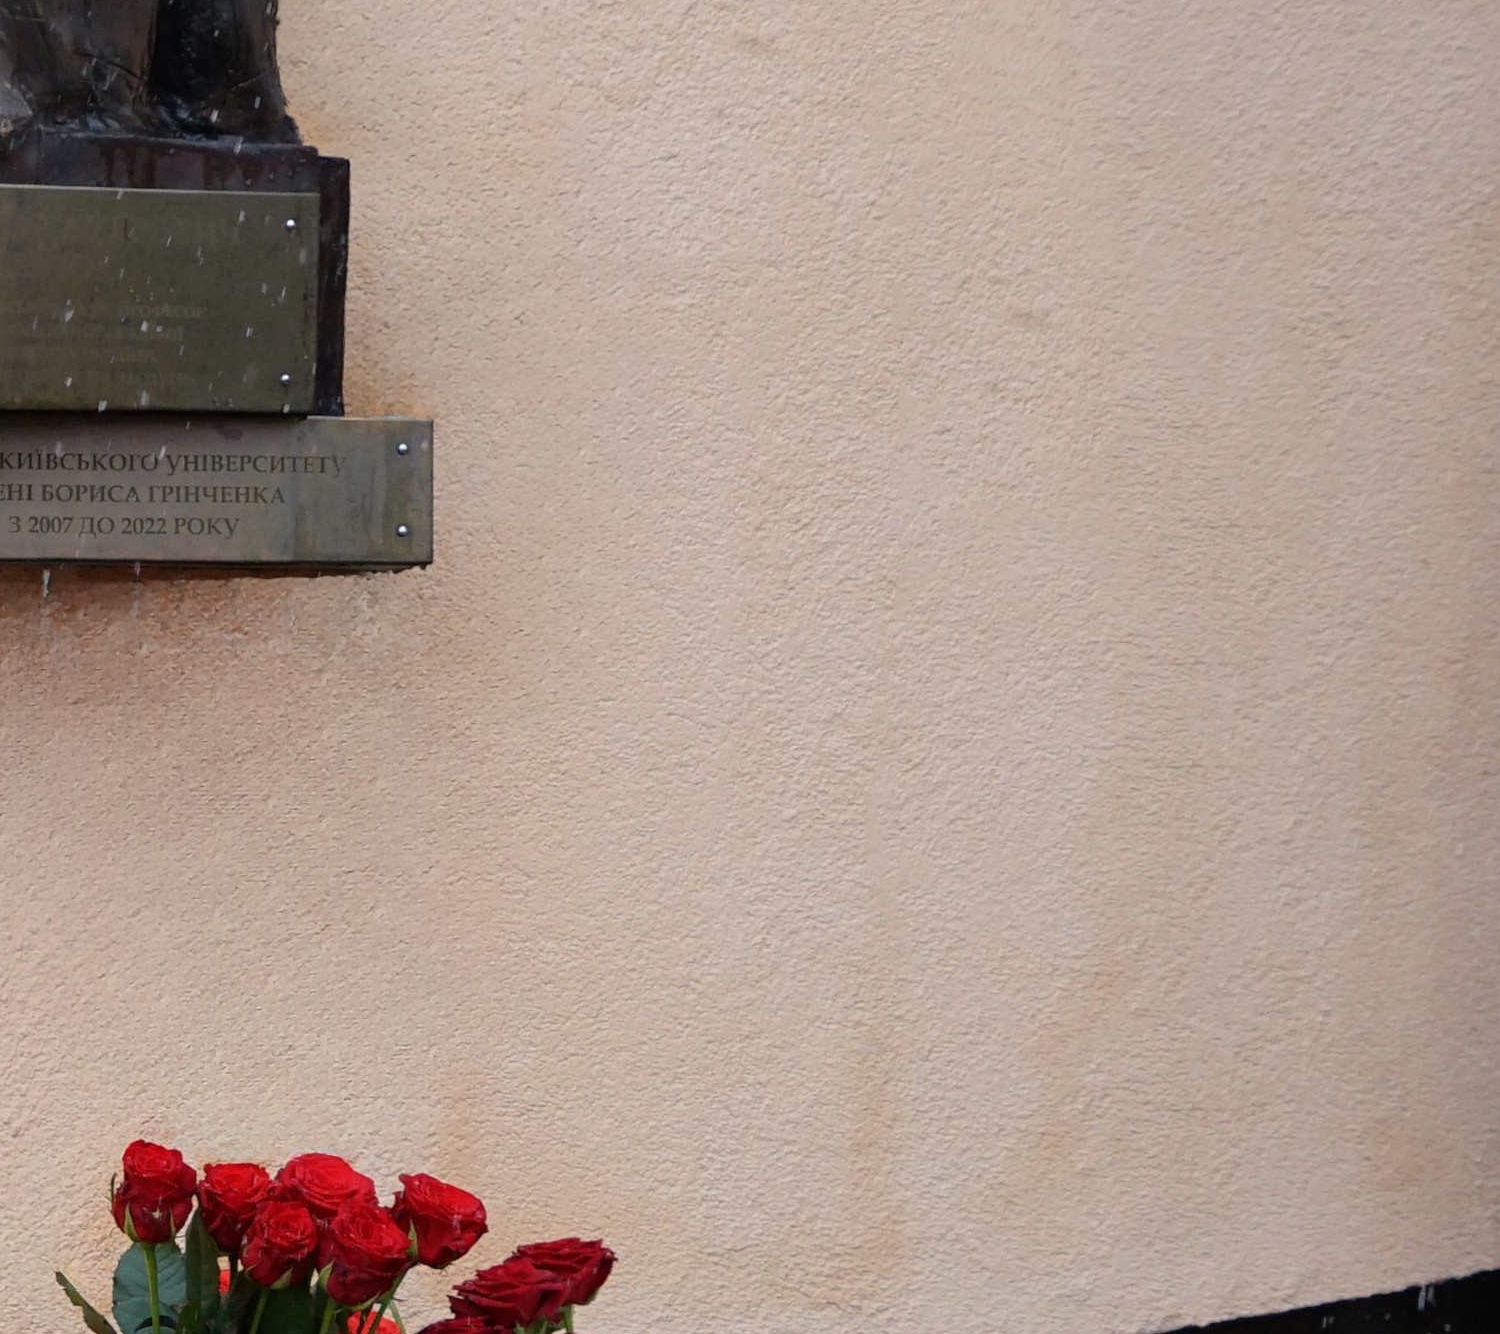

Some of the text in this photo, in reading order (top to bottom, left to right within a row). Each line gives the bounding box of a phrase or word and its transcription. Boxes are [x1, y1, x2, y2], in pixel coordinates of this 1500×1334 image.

[0, 449, 159, 472] КИЇВСЬКОГО
[165, 454, 347, 478] УНІВЕРСИТЕТУ
[41, 484, 140, 504] БОРИСА
[148, 485, 286, 504] ГРІНЧЕНКА
[28, 516, 74, 535] 2007
[78, 517, 115, 538] ДО
[121, 517, 167, 535] 2022
[174, 518, 240, 540] РОКУ
